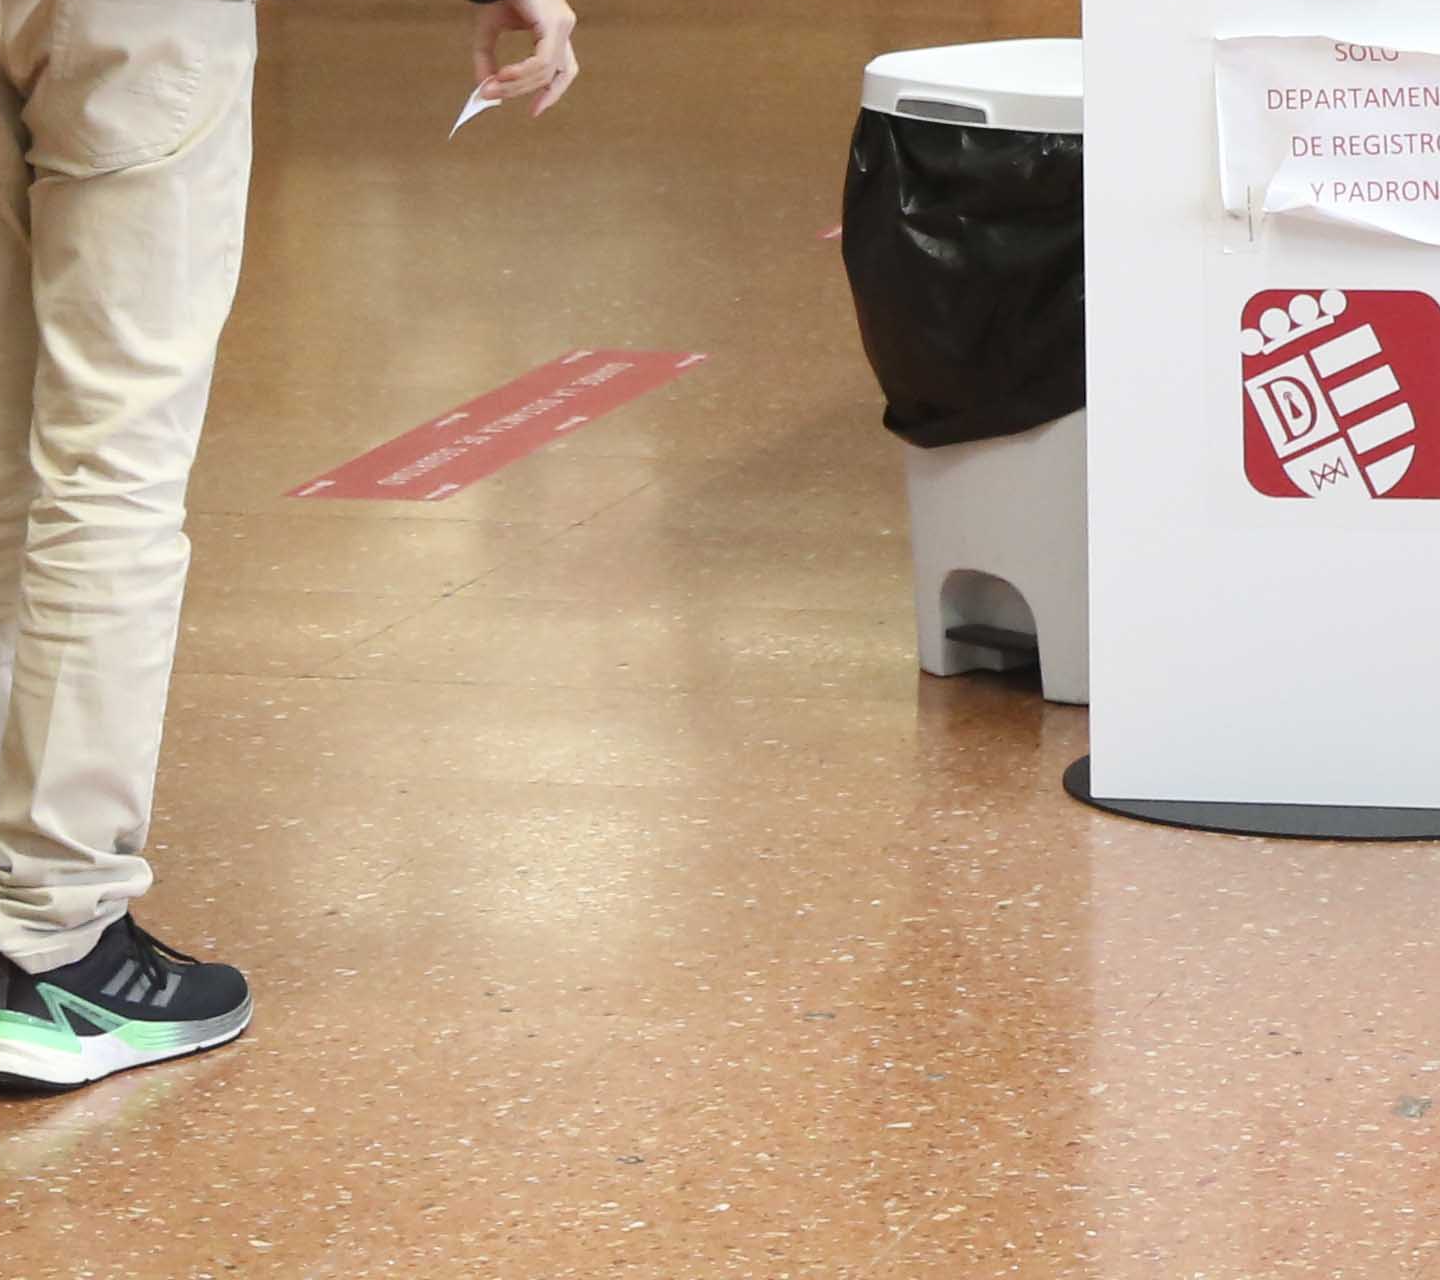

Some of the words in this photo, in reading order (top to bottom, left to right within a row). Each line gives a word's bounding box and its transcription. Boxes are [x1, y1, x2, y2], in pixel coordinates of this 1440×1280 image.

[1291, 136, 1325, 158] DE
[1310, 183, 1325, 205] Y
[1332, 180, 1440, 204] PADRON
